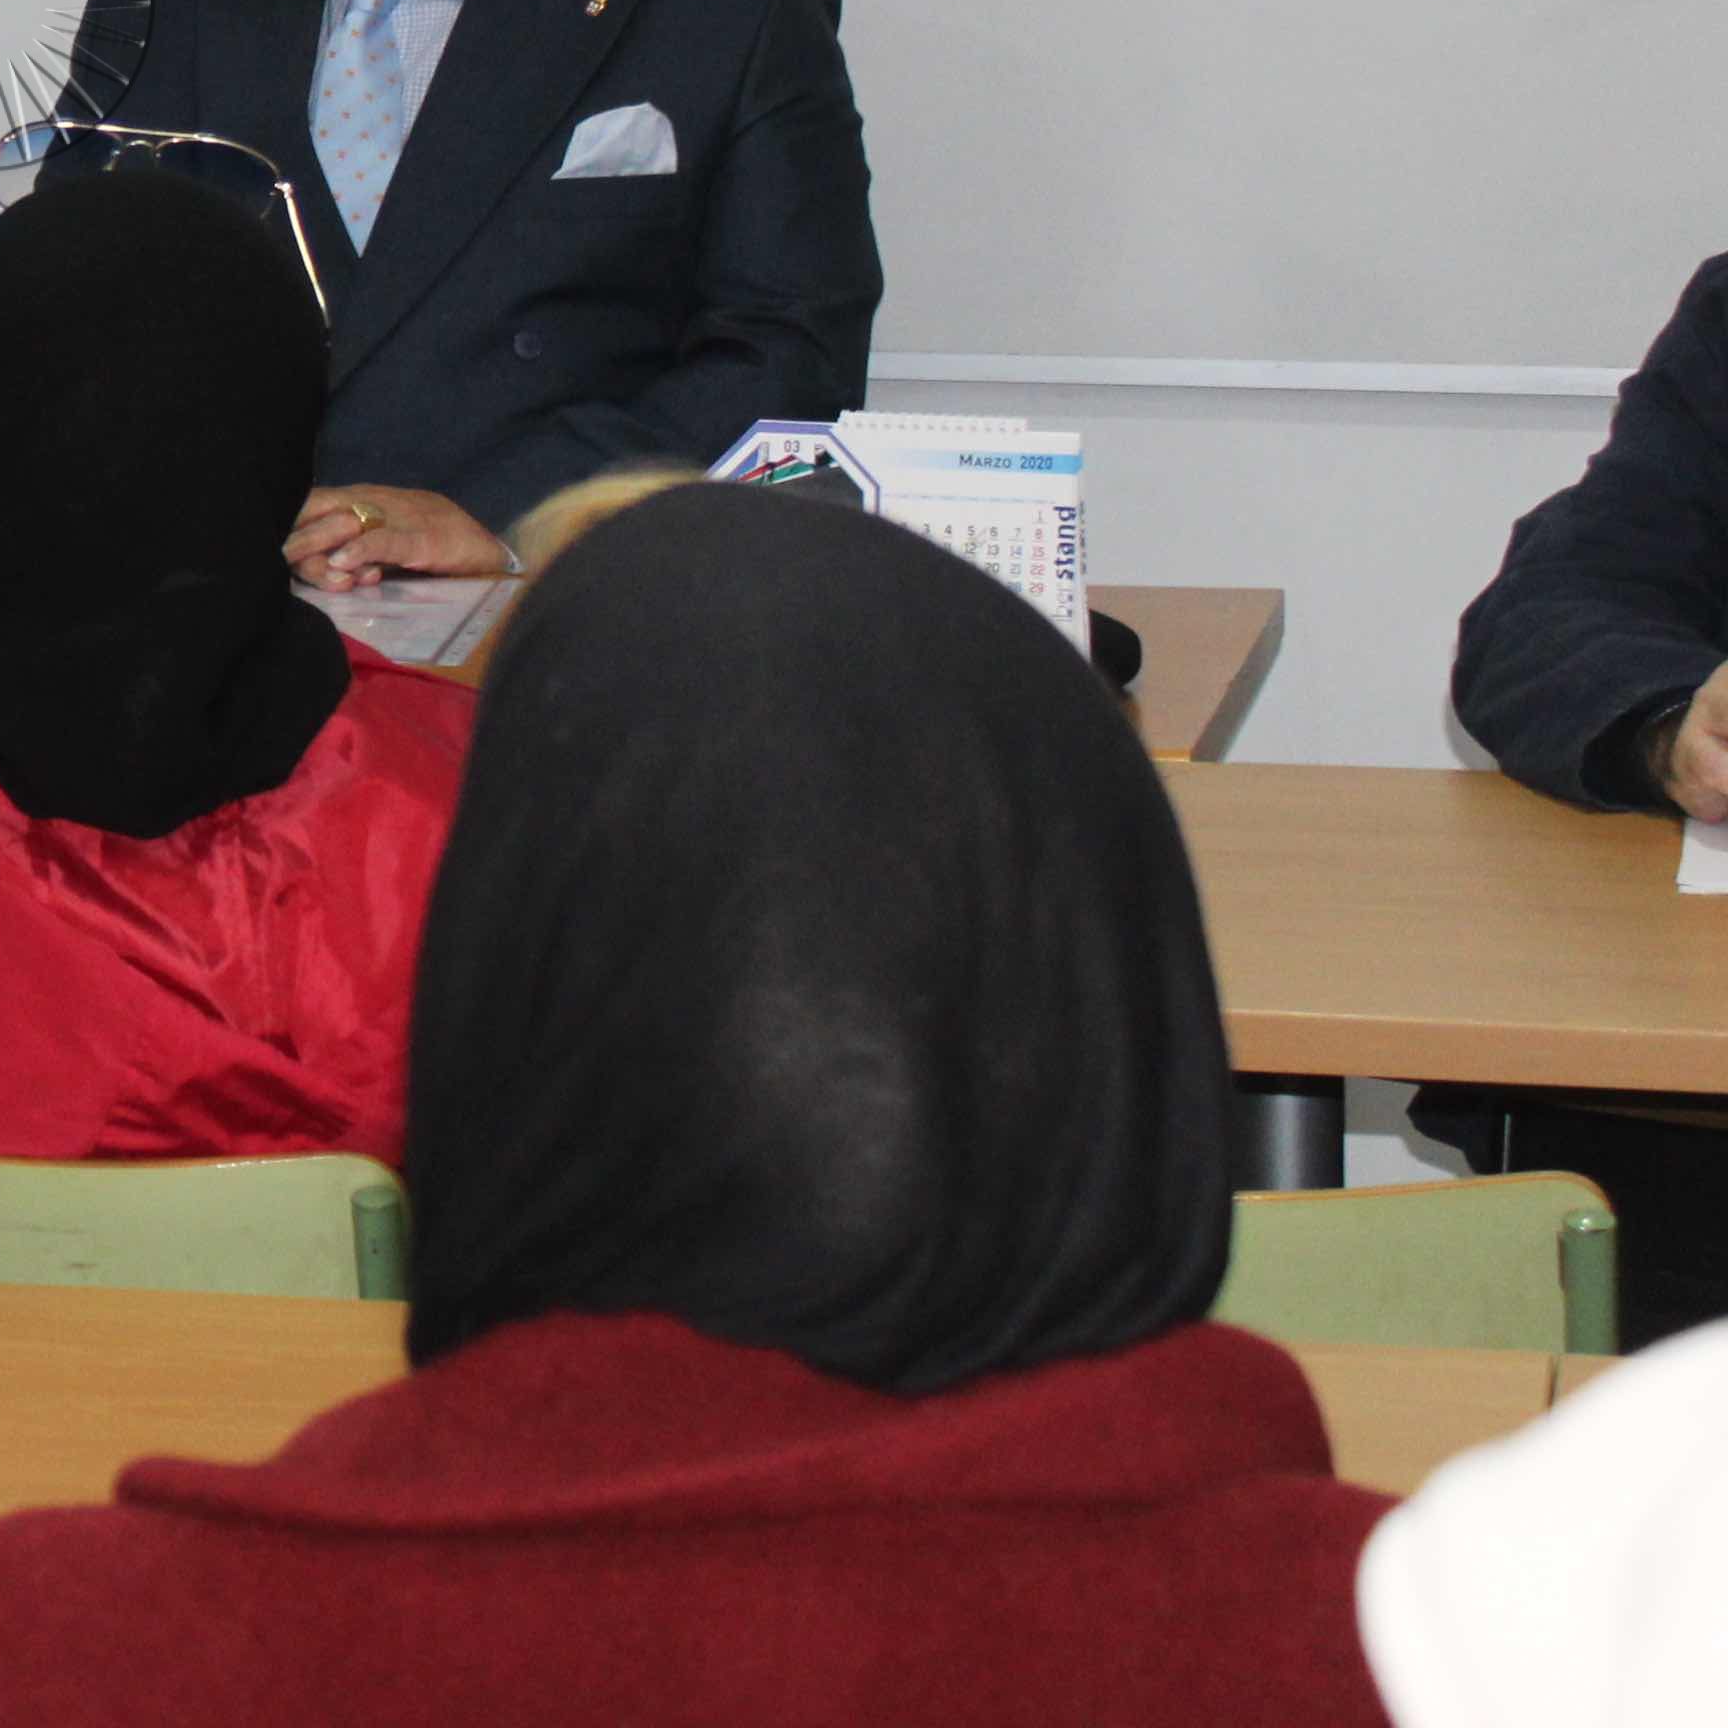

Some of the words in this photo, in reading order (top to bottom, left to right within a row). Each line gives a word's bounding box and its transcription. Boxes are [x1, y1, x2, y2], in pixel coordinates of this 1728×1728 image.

[783, 440, 800, 452] 03
[1019, 456, 1053, 470] 2020
[967, 525, 976, 537] 5
[990, 526, 999, 537] 6
[987, 543, 1000, 556] 13
